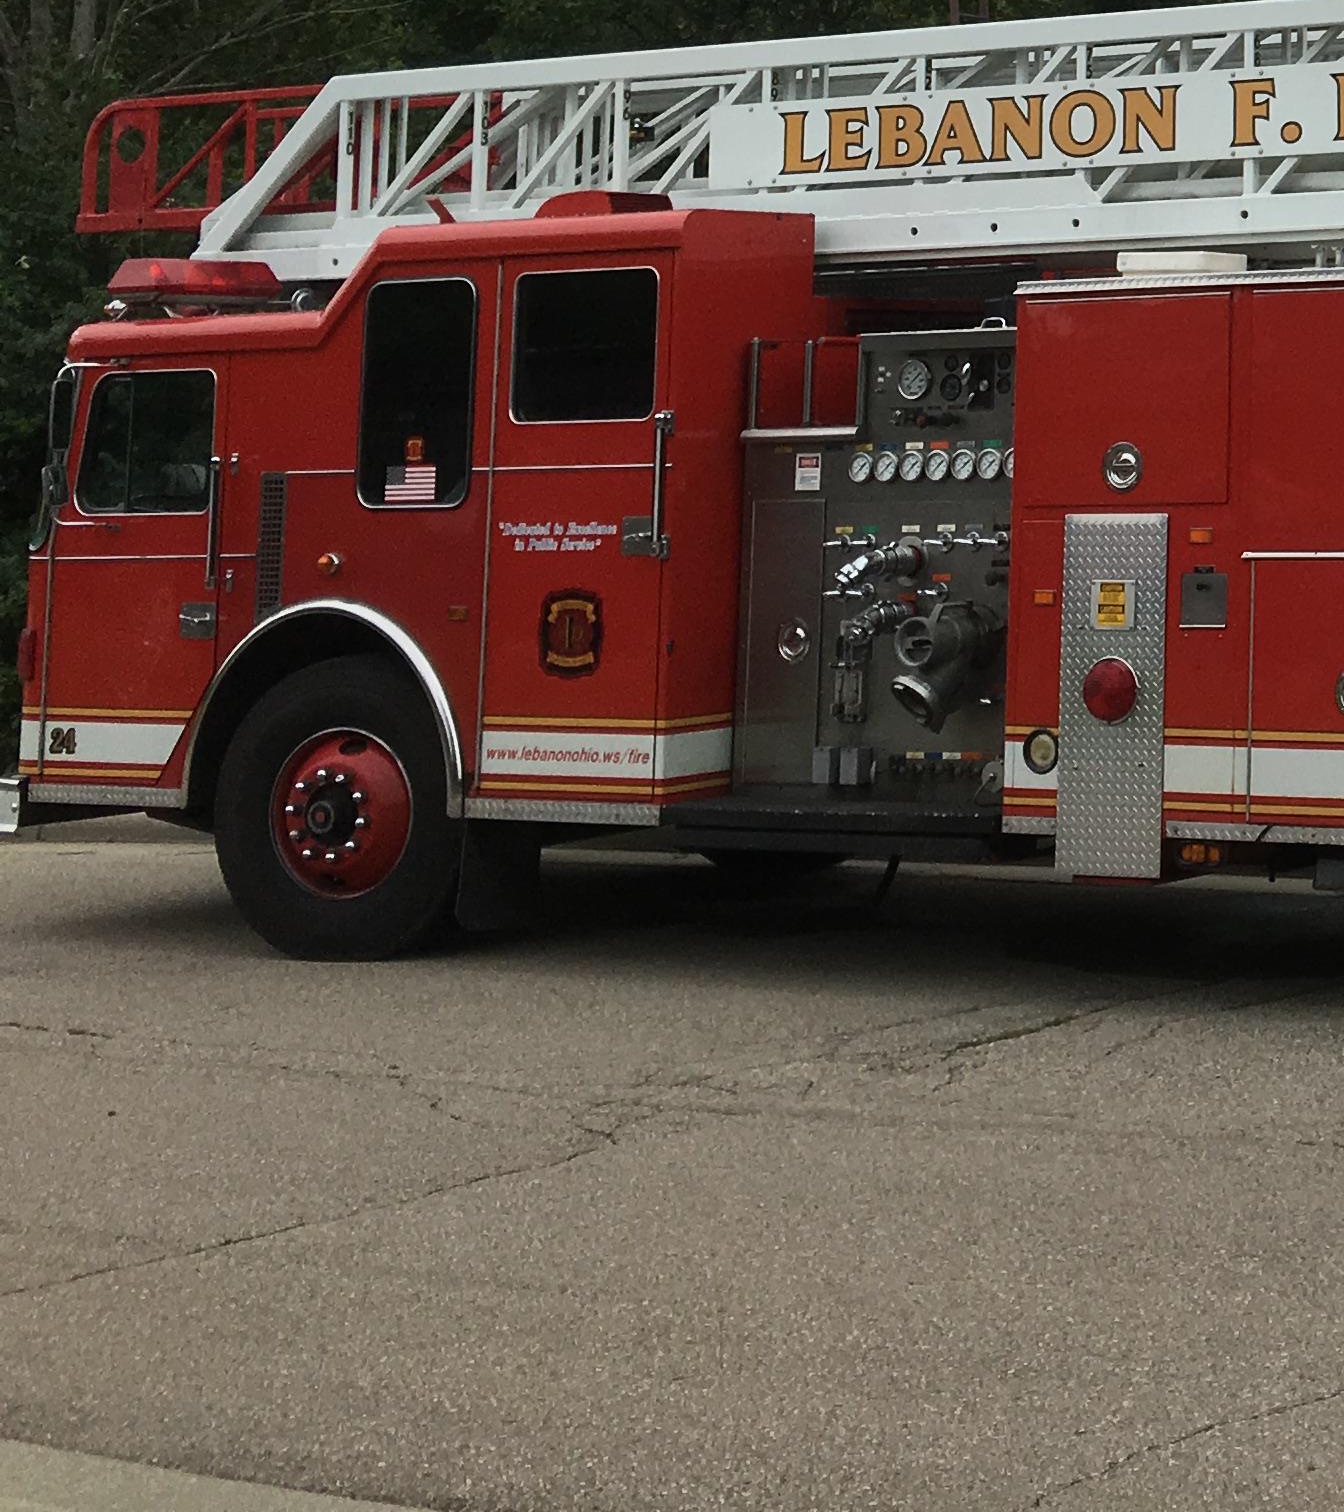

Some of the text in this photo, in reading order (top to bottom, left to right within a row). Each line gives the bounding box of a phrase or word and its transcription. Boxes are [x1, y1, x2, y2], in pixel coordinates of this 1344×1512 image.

[781, 83, 1180, 176] LEBANON
[1231, 77, 1303, 147] F.
[48, 727, 77, 754] 24
[486, 746, 650, 765] www.lebanonohio.ws/fire
